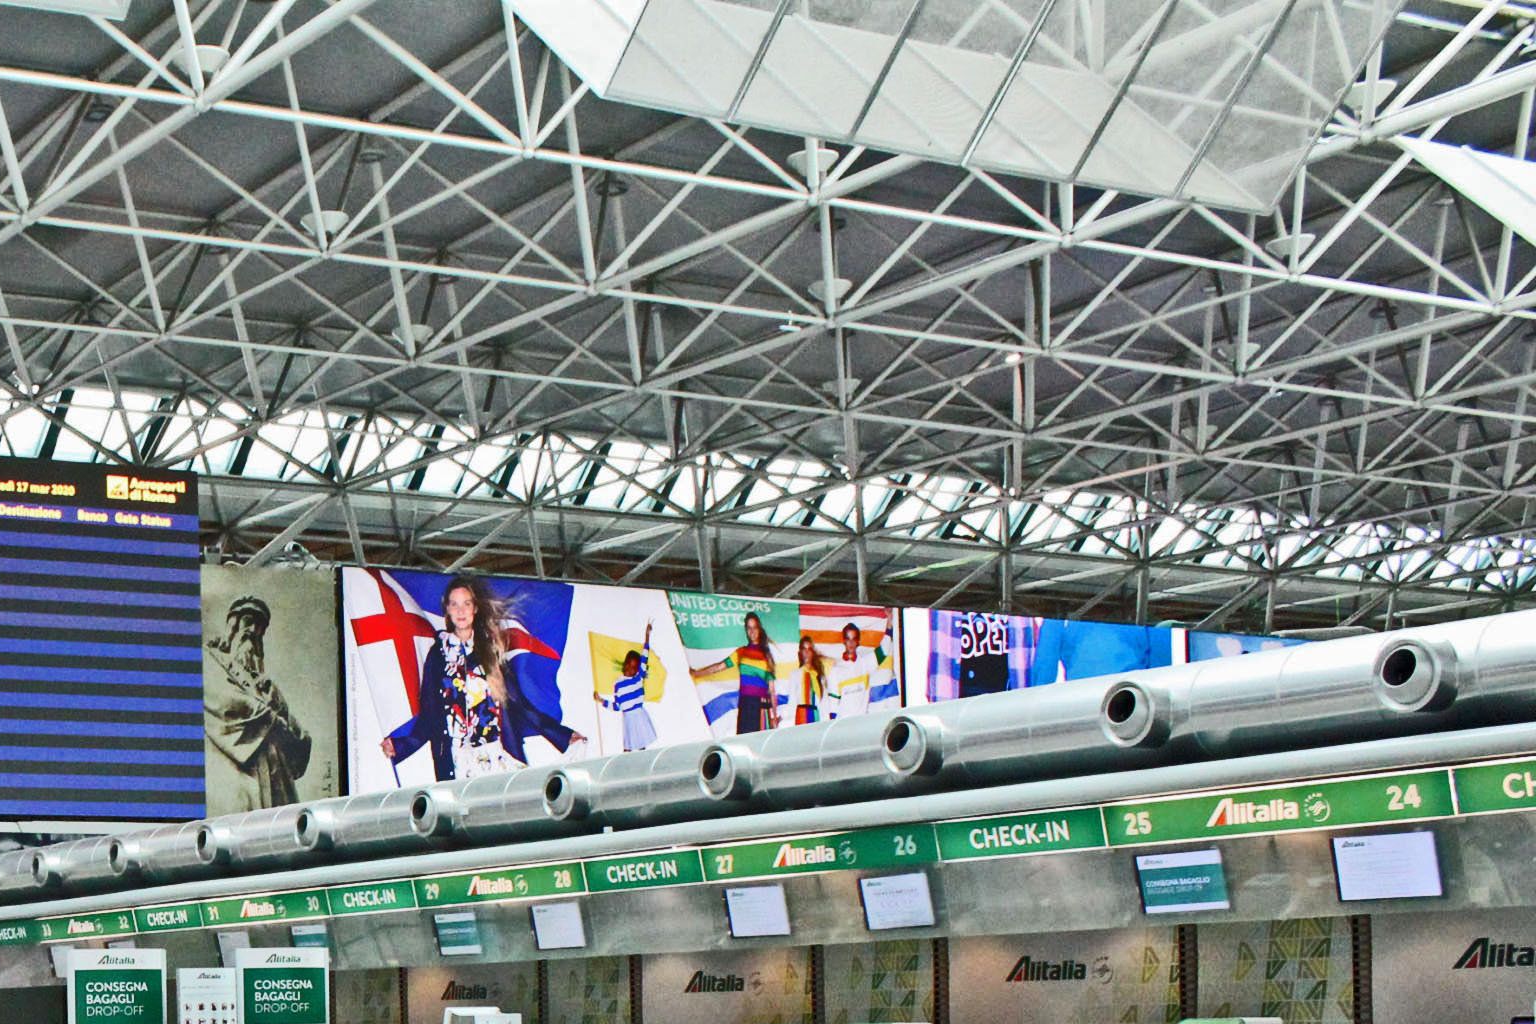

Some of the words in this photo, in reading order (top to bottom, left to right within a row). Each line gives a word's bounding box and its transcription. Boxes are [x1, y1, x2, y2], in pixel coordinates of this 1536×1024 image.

[15, 481, 29, 493] 17
[30, 484, 50, 495] mar
[77, 509, 109, 523] Banco
[115, 512, 139, 525] Gate
[141, 513, 172, 527] Status
[719, 599, 771, 613] COLORS
[1124, 811, 1153, 837] 25
[1206, 797, 1300, 828] Alitalia
[1385, 784, 1423, 811] 24
[969, 818, 1072, 851] CHECK-IN
[715, 855, 734, 875] 27
[772, 843, 836, 868] Alitalia
[893, 834, 917, 856] 26
[607, 860, 679, 884] CHECK-IN
[424, 883, 440, 900] 29
[467, 875, 514, 897] Alitalia
[553, 869, 572, 889] 28
[240, 899, 275, 919] Alitalia
[307, 895, 320, 912] 30
[343, 888, 397, 908] CHECK-IN
[68, 919, 95, 935] Alitalia
[146, 909, 188, 927] CHECK-IN
[97, 955, 135, 965] Alitalia
[266, 953, 302, 964] Alitalia
[1005, 956, 1087, 982] Alitalia
[85, 981, 148, 993] CONSEGNA
[254, 979, 313, 991] CONSEGNA
[441, 980, 487, 1001] Alitalia
[684, 970, 745, 994] Alitalia
[85, 993, 135, 1005] BAGAGLI
[254, 990, 301, 1002] BAGAGLI
[86, 1005, 145, 1017] DROP-OFF
[254, 1002, 310, 1014] DROP-OFF
